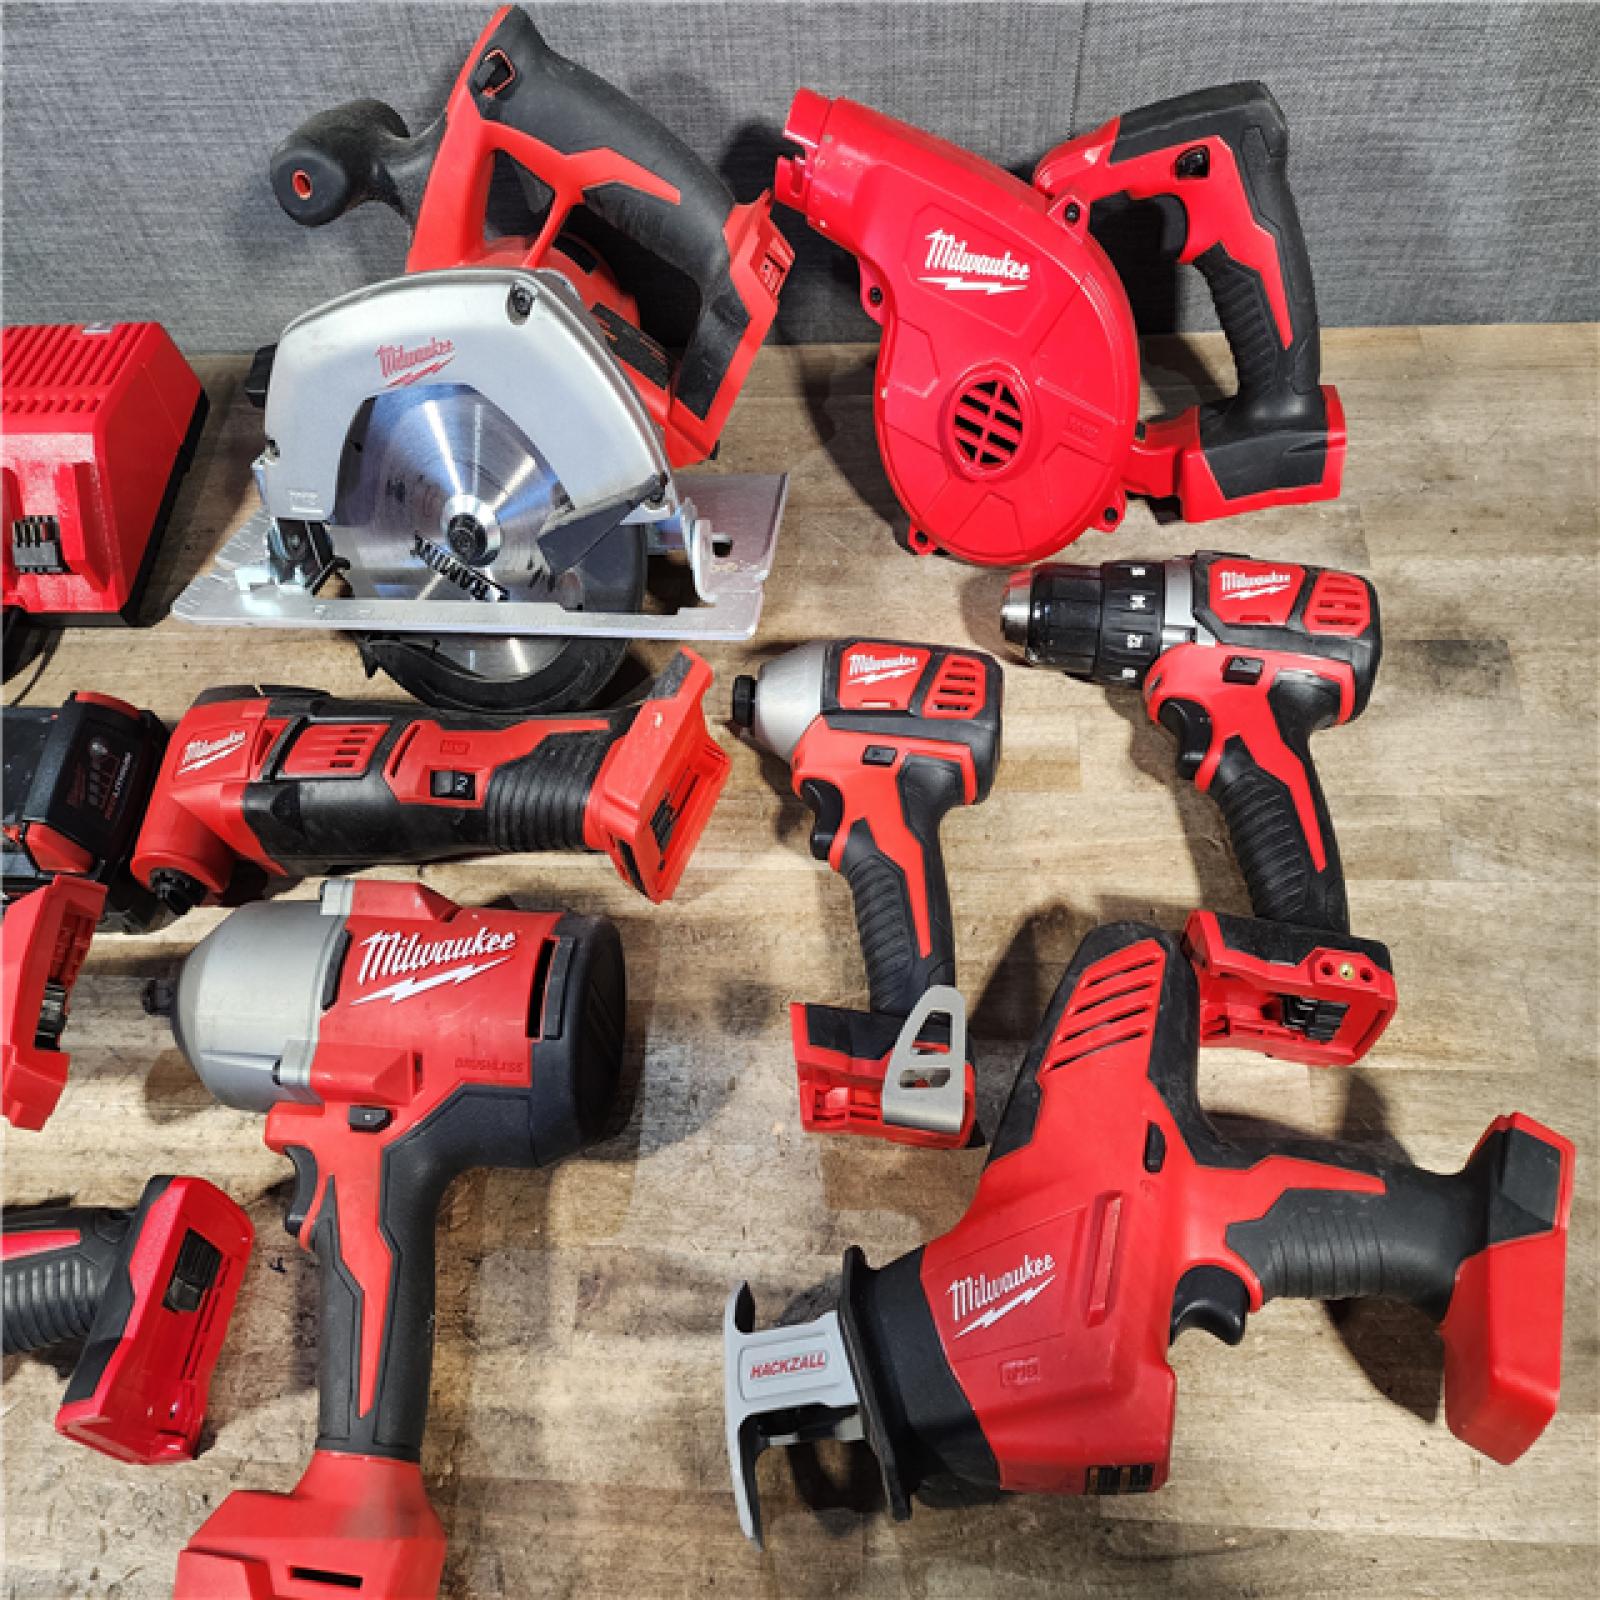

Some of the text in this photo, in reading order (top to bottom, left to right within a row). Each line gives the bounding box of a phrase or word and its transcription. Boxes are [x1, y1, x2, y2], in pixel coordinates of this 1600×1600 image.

[924, 228, 1031, 281] Milwaukee
[375, 336, 455, 378] Milwaukee
[1219, 570, 1291, 592] Milwaukee
[847, 652, 918, 676] Milwaukee
[182, 730, 246, 766] Milwaukee
[357, 927, 517, 986] Milwaukee
[946, 1254, 1056, 1322] Milwaukee
[750, 1351, 826, 1379] HACKZALL
